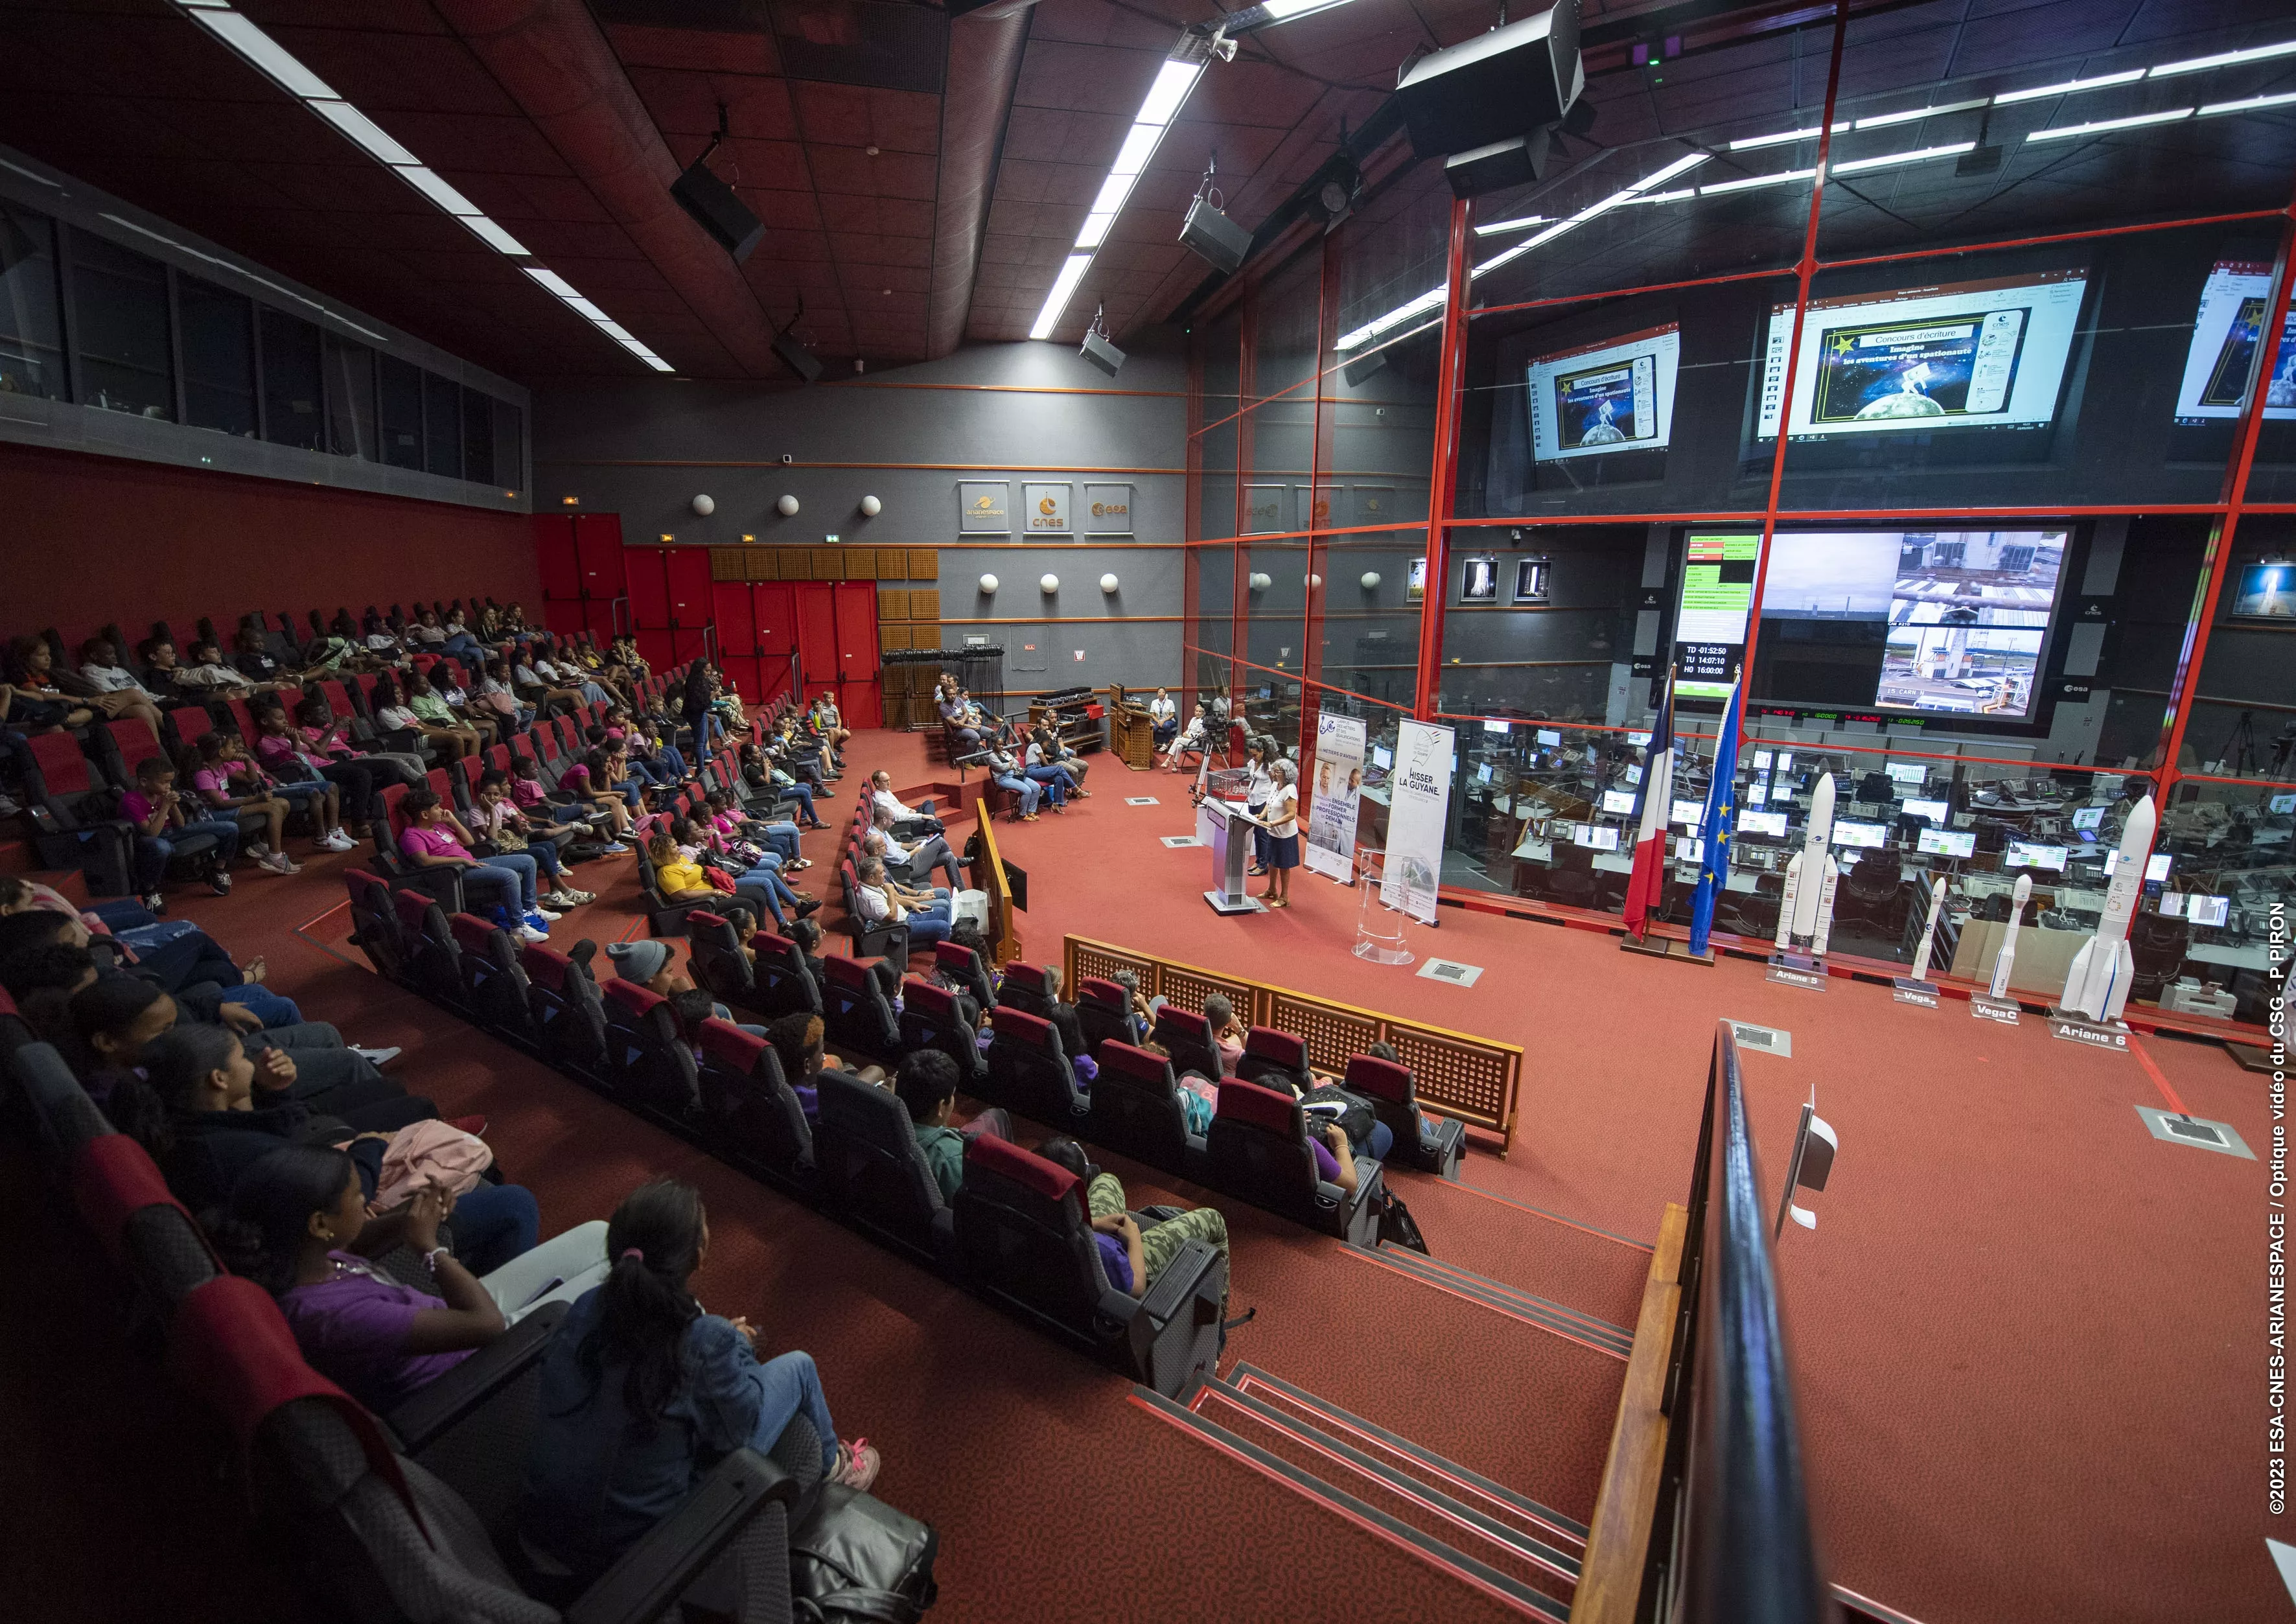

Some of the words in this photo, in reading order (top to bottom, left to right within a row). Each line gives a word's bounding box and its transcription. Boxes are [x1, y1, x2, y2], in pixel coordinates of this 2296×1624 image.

[1875, 336, 1914, 344] Concours
[1917, 330, 1956, 340] d'écriture
[1890, 344, 1925, 354] Imagine
[1855, 354, 1897, 364] aventures
[1581, 377, 1601, 386] Concours
[1602, 373, 1621, 382] d'écriture
[1589, 385, 1607, 393] Imagine
[1574, 393, 1594, 402] aventures
[1594, 391, 1605, 399] d'un
[1106, 505, 1127, 514] esa
[1032, 518, 1063, 527] cnes
[1698, 647, 1726, 655] -01:52:50
[1697, 666, 1724, 675] 16:00:00
[1335, 733, 1360, 742] QUALIFICATIONS
[1339, 752, 1358, 761] D'AVENIR
[1409, 767, 1433, 785] HISSER
[1399, 778, 1409, 787] LA
[1409, 782, 1439, 796] GUYANE
[1328, 803, 1347, 814] FORMER
[1332, 798, 1356, 810] ENSEMBLE
[1316, 806, 1356, 823] PROFESSIONNELS
[1325, 815, 1343, 825] DEMAIN
[1776, 970, 1807, 982] Ariane
[1904, 992, 1929, 1003] Vega
[1977, 1004, 2006, 1018] Vega
[2007, 1010, 2017, 1019] C
[2059, 1025, 2109, 1043] Ariane
[2115, 1035, 2126, 1045] 6
